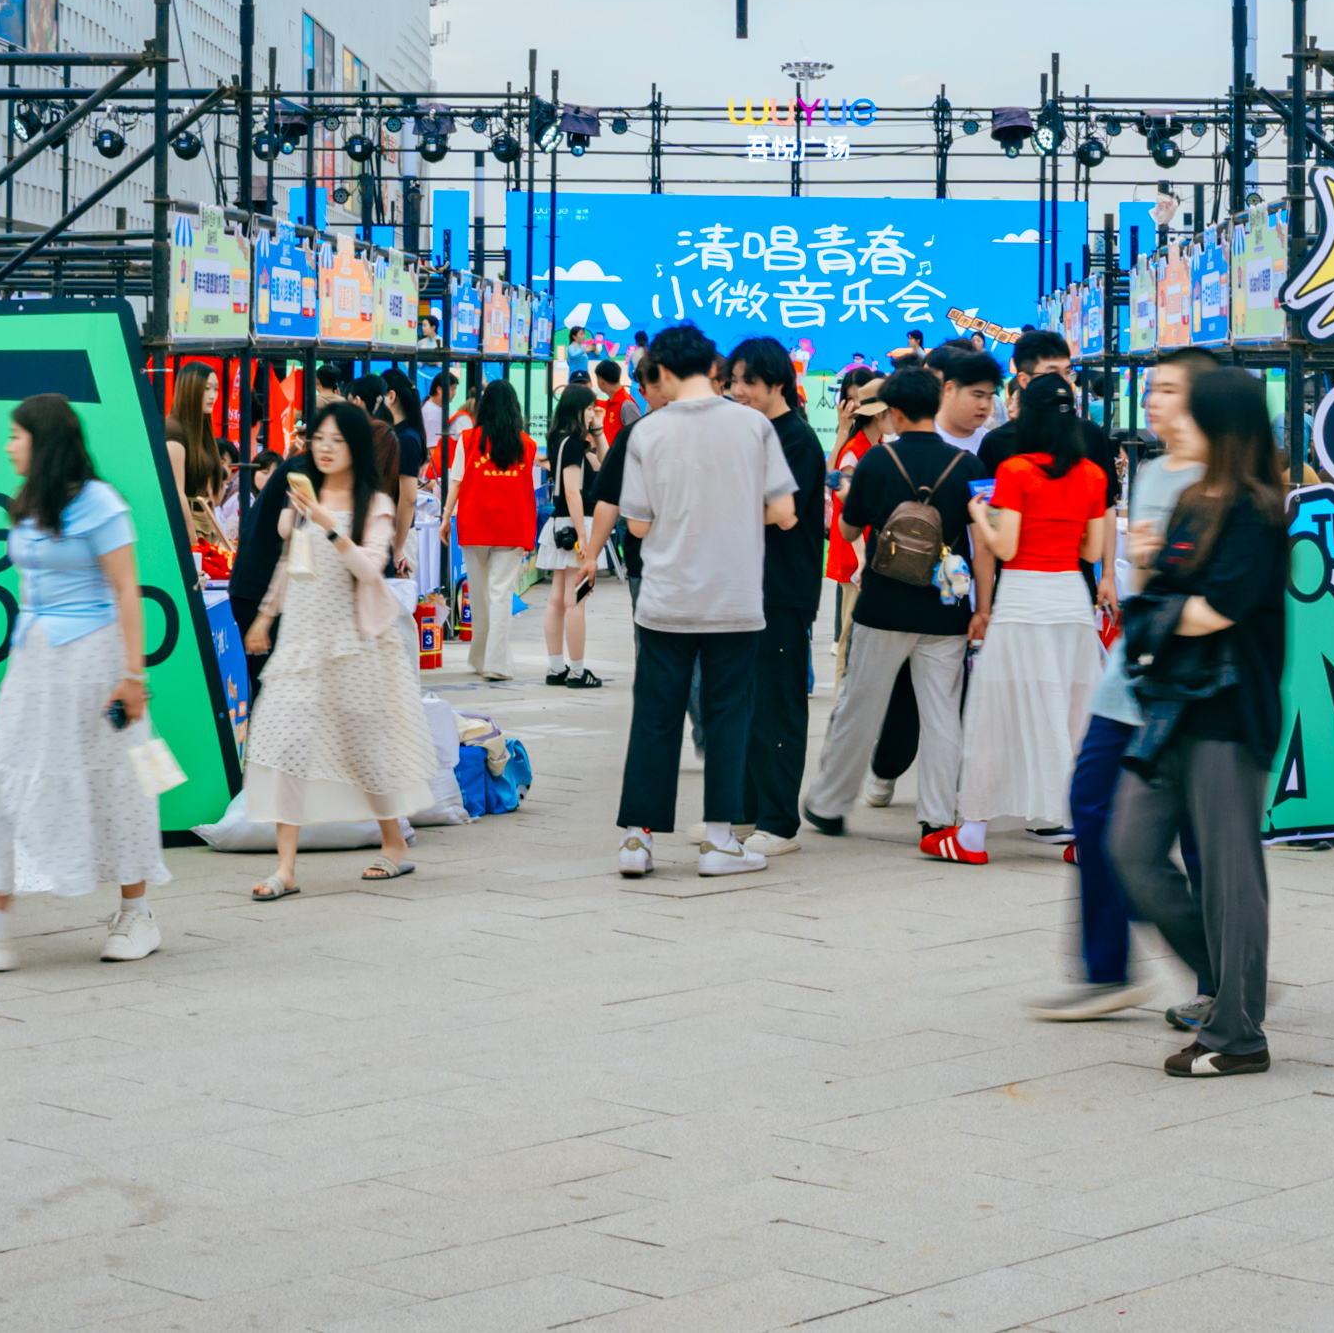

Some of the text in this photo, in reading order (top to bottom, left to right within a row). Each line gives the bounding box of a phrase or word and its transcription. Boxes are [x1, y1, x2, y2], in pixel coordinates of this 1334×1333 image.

[746, 135, 851, 162] 吾悦广场
[674, 223, 916, 276] 清唱青春
[652, 274, 947, 328] 小微音乐会
[425, 635, 433, 645] 3
